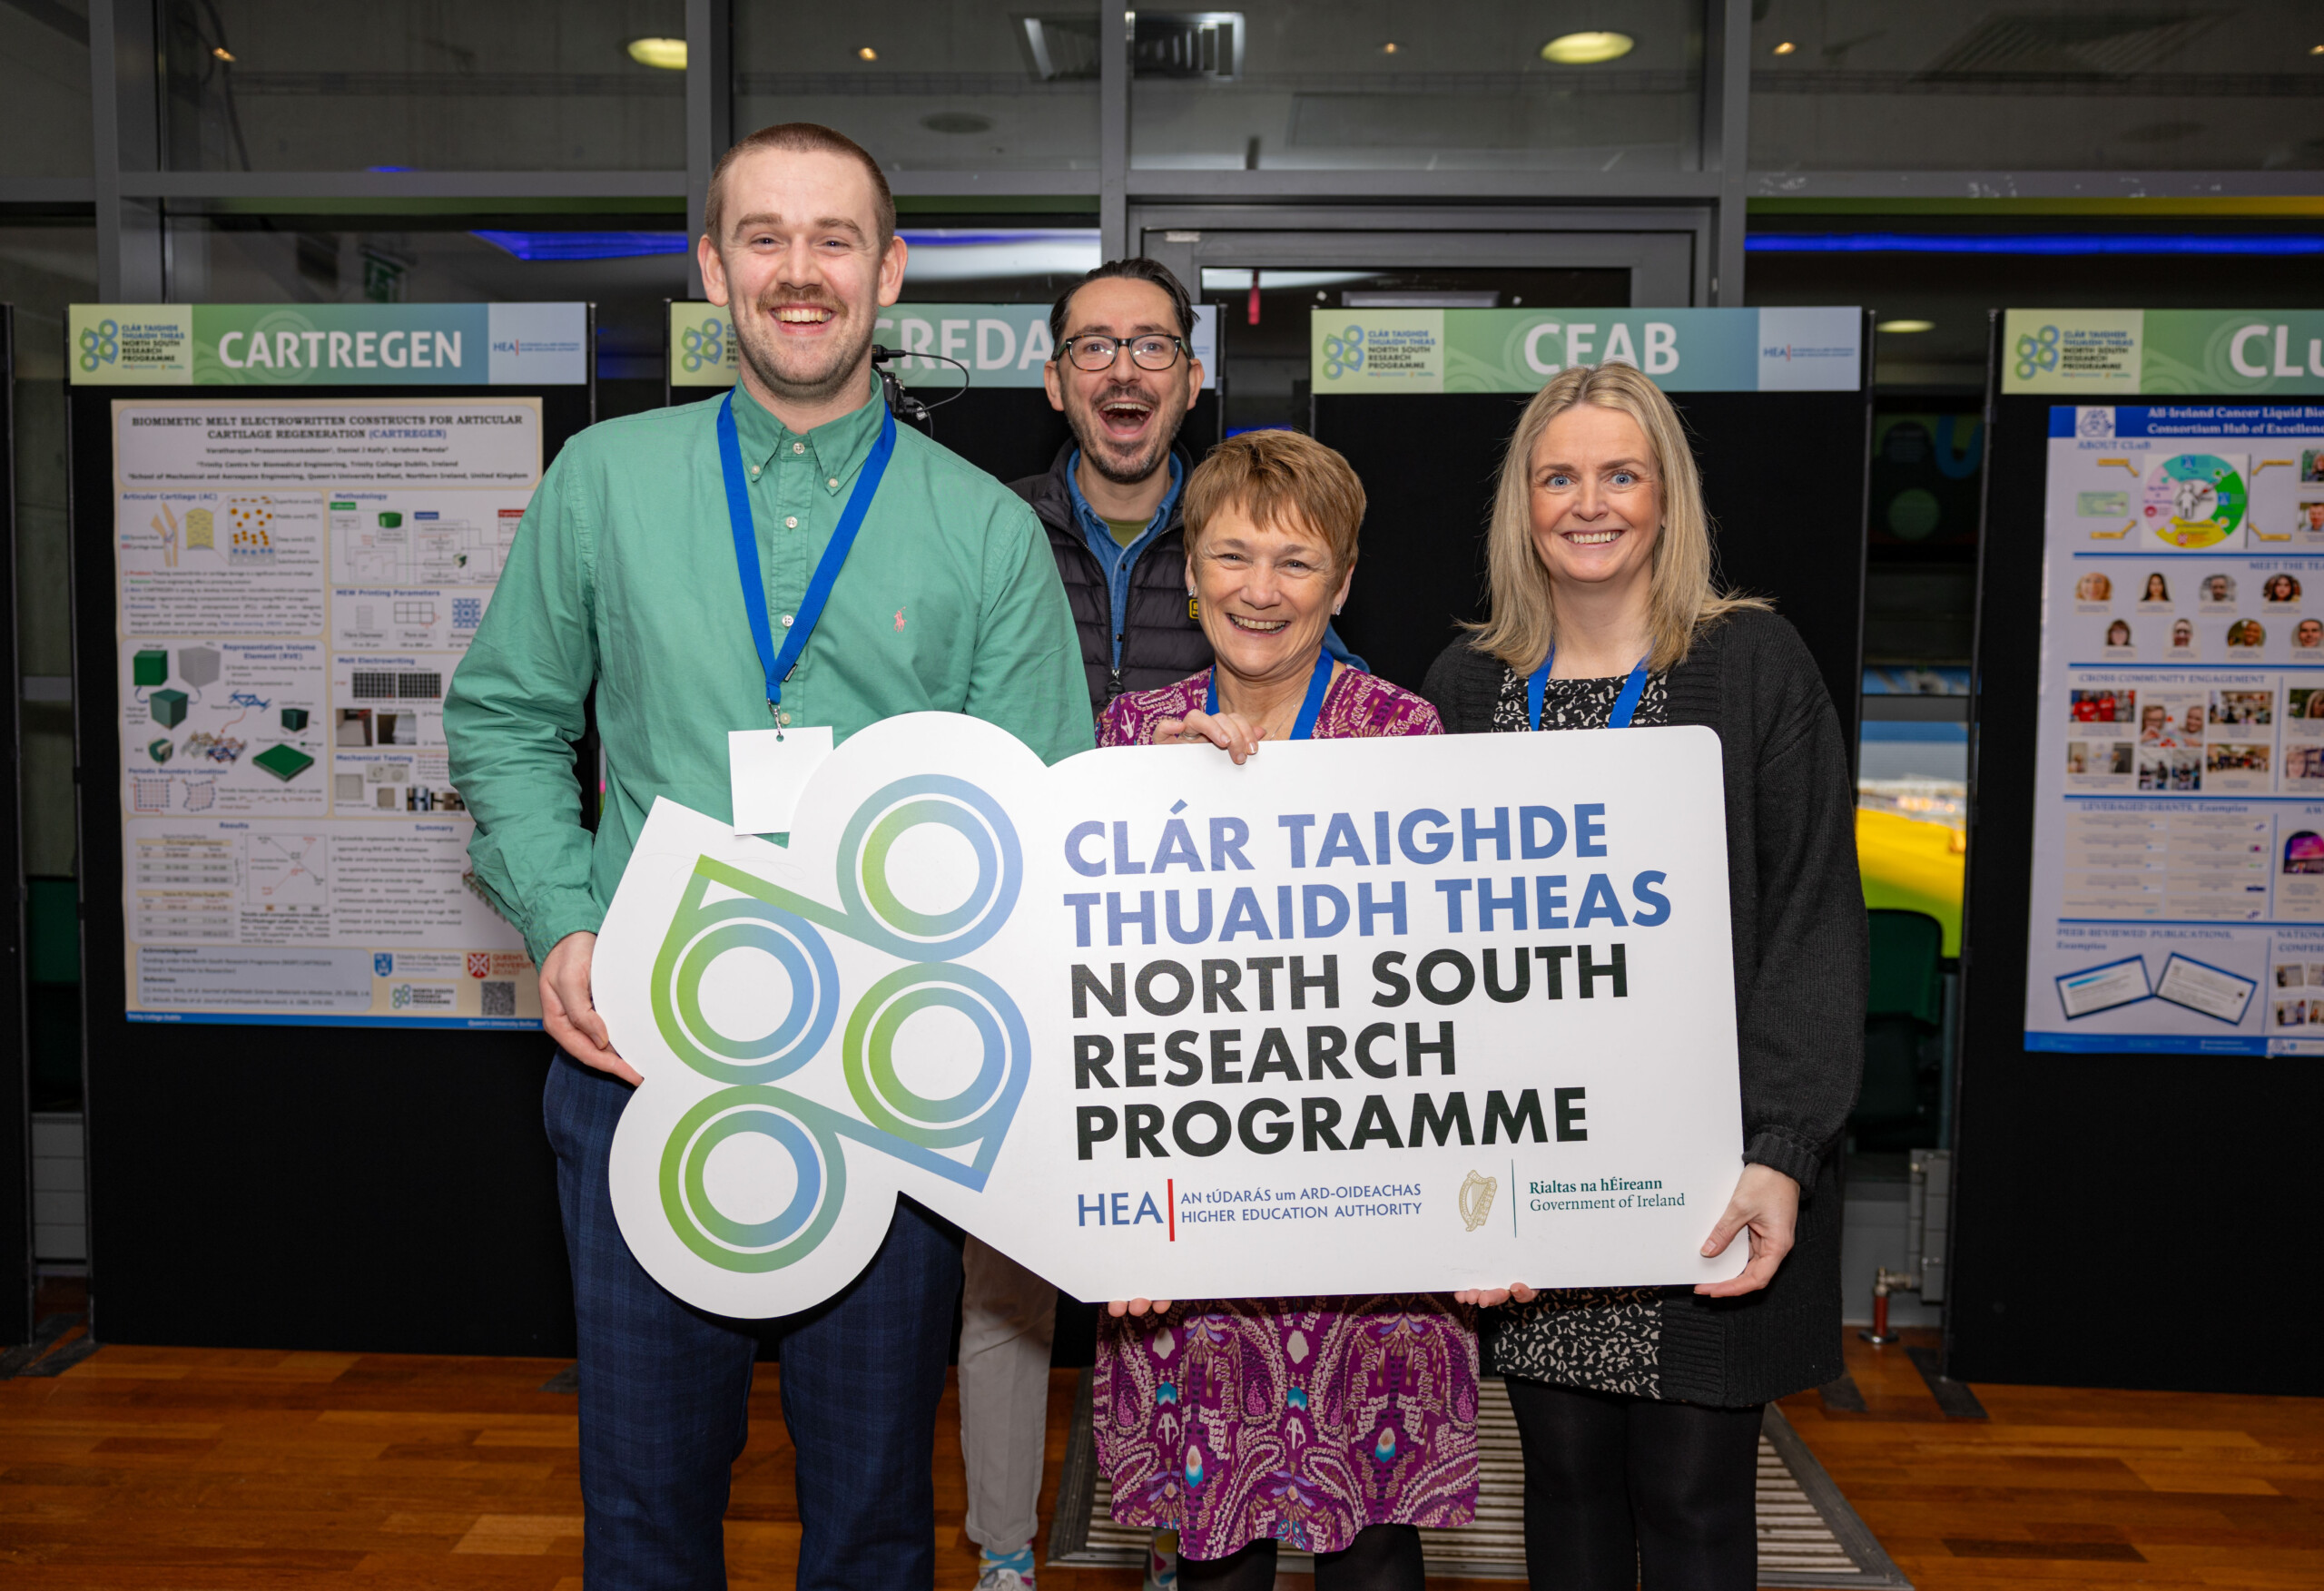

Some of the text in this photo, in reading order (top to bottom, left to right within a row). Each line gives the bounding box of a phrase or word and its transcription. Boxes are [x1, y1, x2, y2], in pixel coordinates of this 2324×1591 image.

[219, 331, 461, 368] CARTREGEN
[493, 342, 515, 352] HEA
[1525, 322, 1679, 375] CEAB
[1763, 348, 1787, 357] HEA
[2216, 408, 2260, 417] Cancer
[2262, 408, 2302, 419] Liquid
[132, 416, 522, 426] BIOMIMETIC MELT ELECTROWRITTEN CONSTRUCTS FOR ARTICULAR
[208, 429, 447, 439] CARTILAGE REGENERATION (CARTREGEN)
[2147, 423, 2221, 434] Consortium
[2223, 424, 2250, 434] Hub
[2251, 424, 2264, 434] of
[2078, 441, 2117, 449] ABOUT
[160, 493, 197, 501] Cartilage
[199, 493, 217, 501] (AC)
[335, 493, 387, 501] Methodology
[2189, 674, 2266, 683] ENGAGEMENT
[158, 768, 192, 776] Boundary
[2199, 804, 2248, 813] Examples
[415, 824, 454, 832] Summary
[1064, 799, 1607, 878] CLÁR TAIGHDE
[1064, 870, 1671, 948] THUAIDH THEAS
[2057, 942, 2106, 951] Examples
[1071, 944, 1628, 1018] NORTH SOUTH
[1073, 1021, 1456, 1089] RESEARCH
[1076, 1087, 1588, 1161] PROGRAMME
[1529, 1177, 1663, 1194] Rialtas na hÉireann
[1180, 1183, 1422, 1204] AN tÚDARÁS um ARD-OIDEACHAS
[1531, 1193, 1685, 1211] Government of Ireland
[1078, 1192, 1163, 1226] HEA
[1181, 1203, 1422, 1222] HIGHER EDUCATION AUTHORITY
